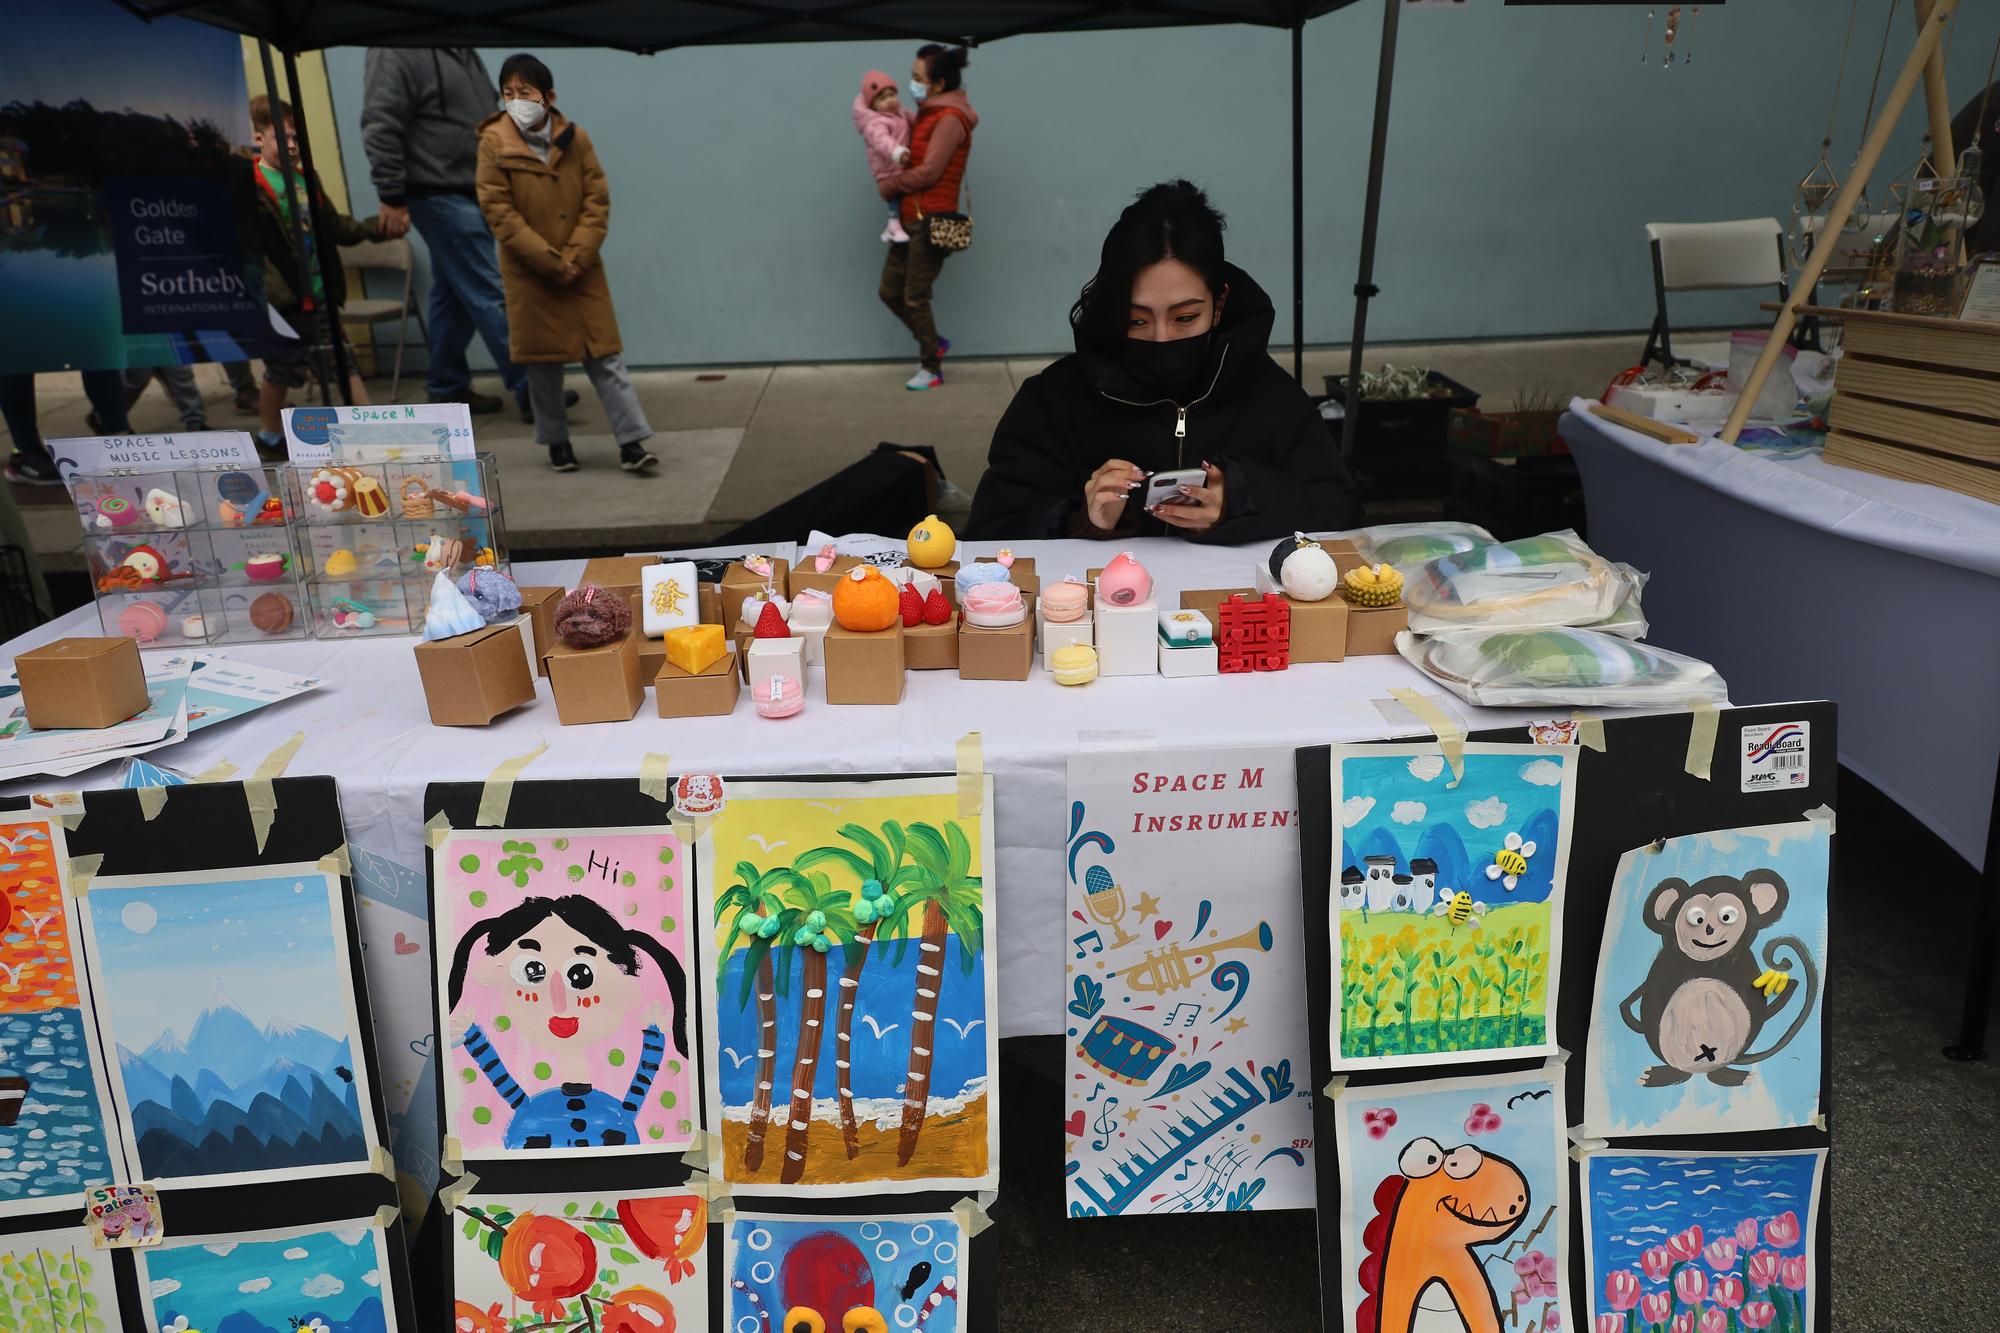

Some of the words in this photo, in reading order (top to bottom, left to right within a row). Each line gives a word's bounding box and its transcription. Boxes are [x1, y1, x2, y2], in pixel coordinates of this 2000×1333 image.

[131, 198, 198, 218] Golden
[135, 226, 185, 245] Gate
[144, 303, 230, 314] INTERNATIONAL
[352, 407, 397, 421] Space
[405, 406, 415, 418] M
[104, 437, 155, 449] SPACE
[164, 436, 175, 446] M
[110, 451, 160, 463] MUSIC
[170, 447, 240, 460] LESSONS
[1132, 772, 1227, 793] SPACE
[1238, 768, 1265, 789] M
[588, 850, 619, 884] Hi
[94, 1187, 142, 1202] STAR
